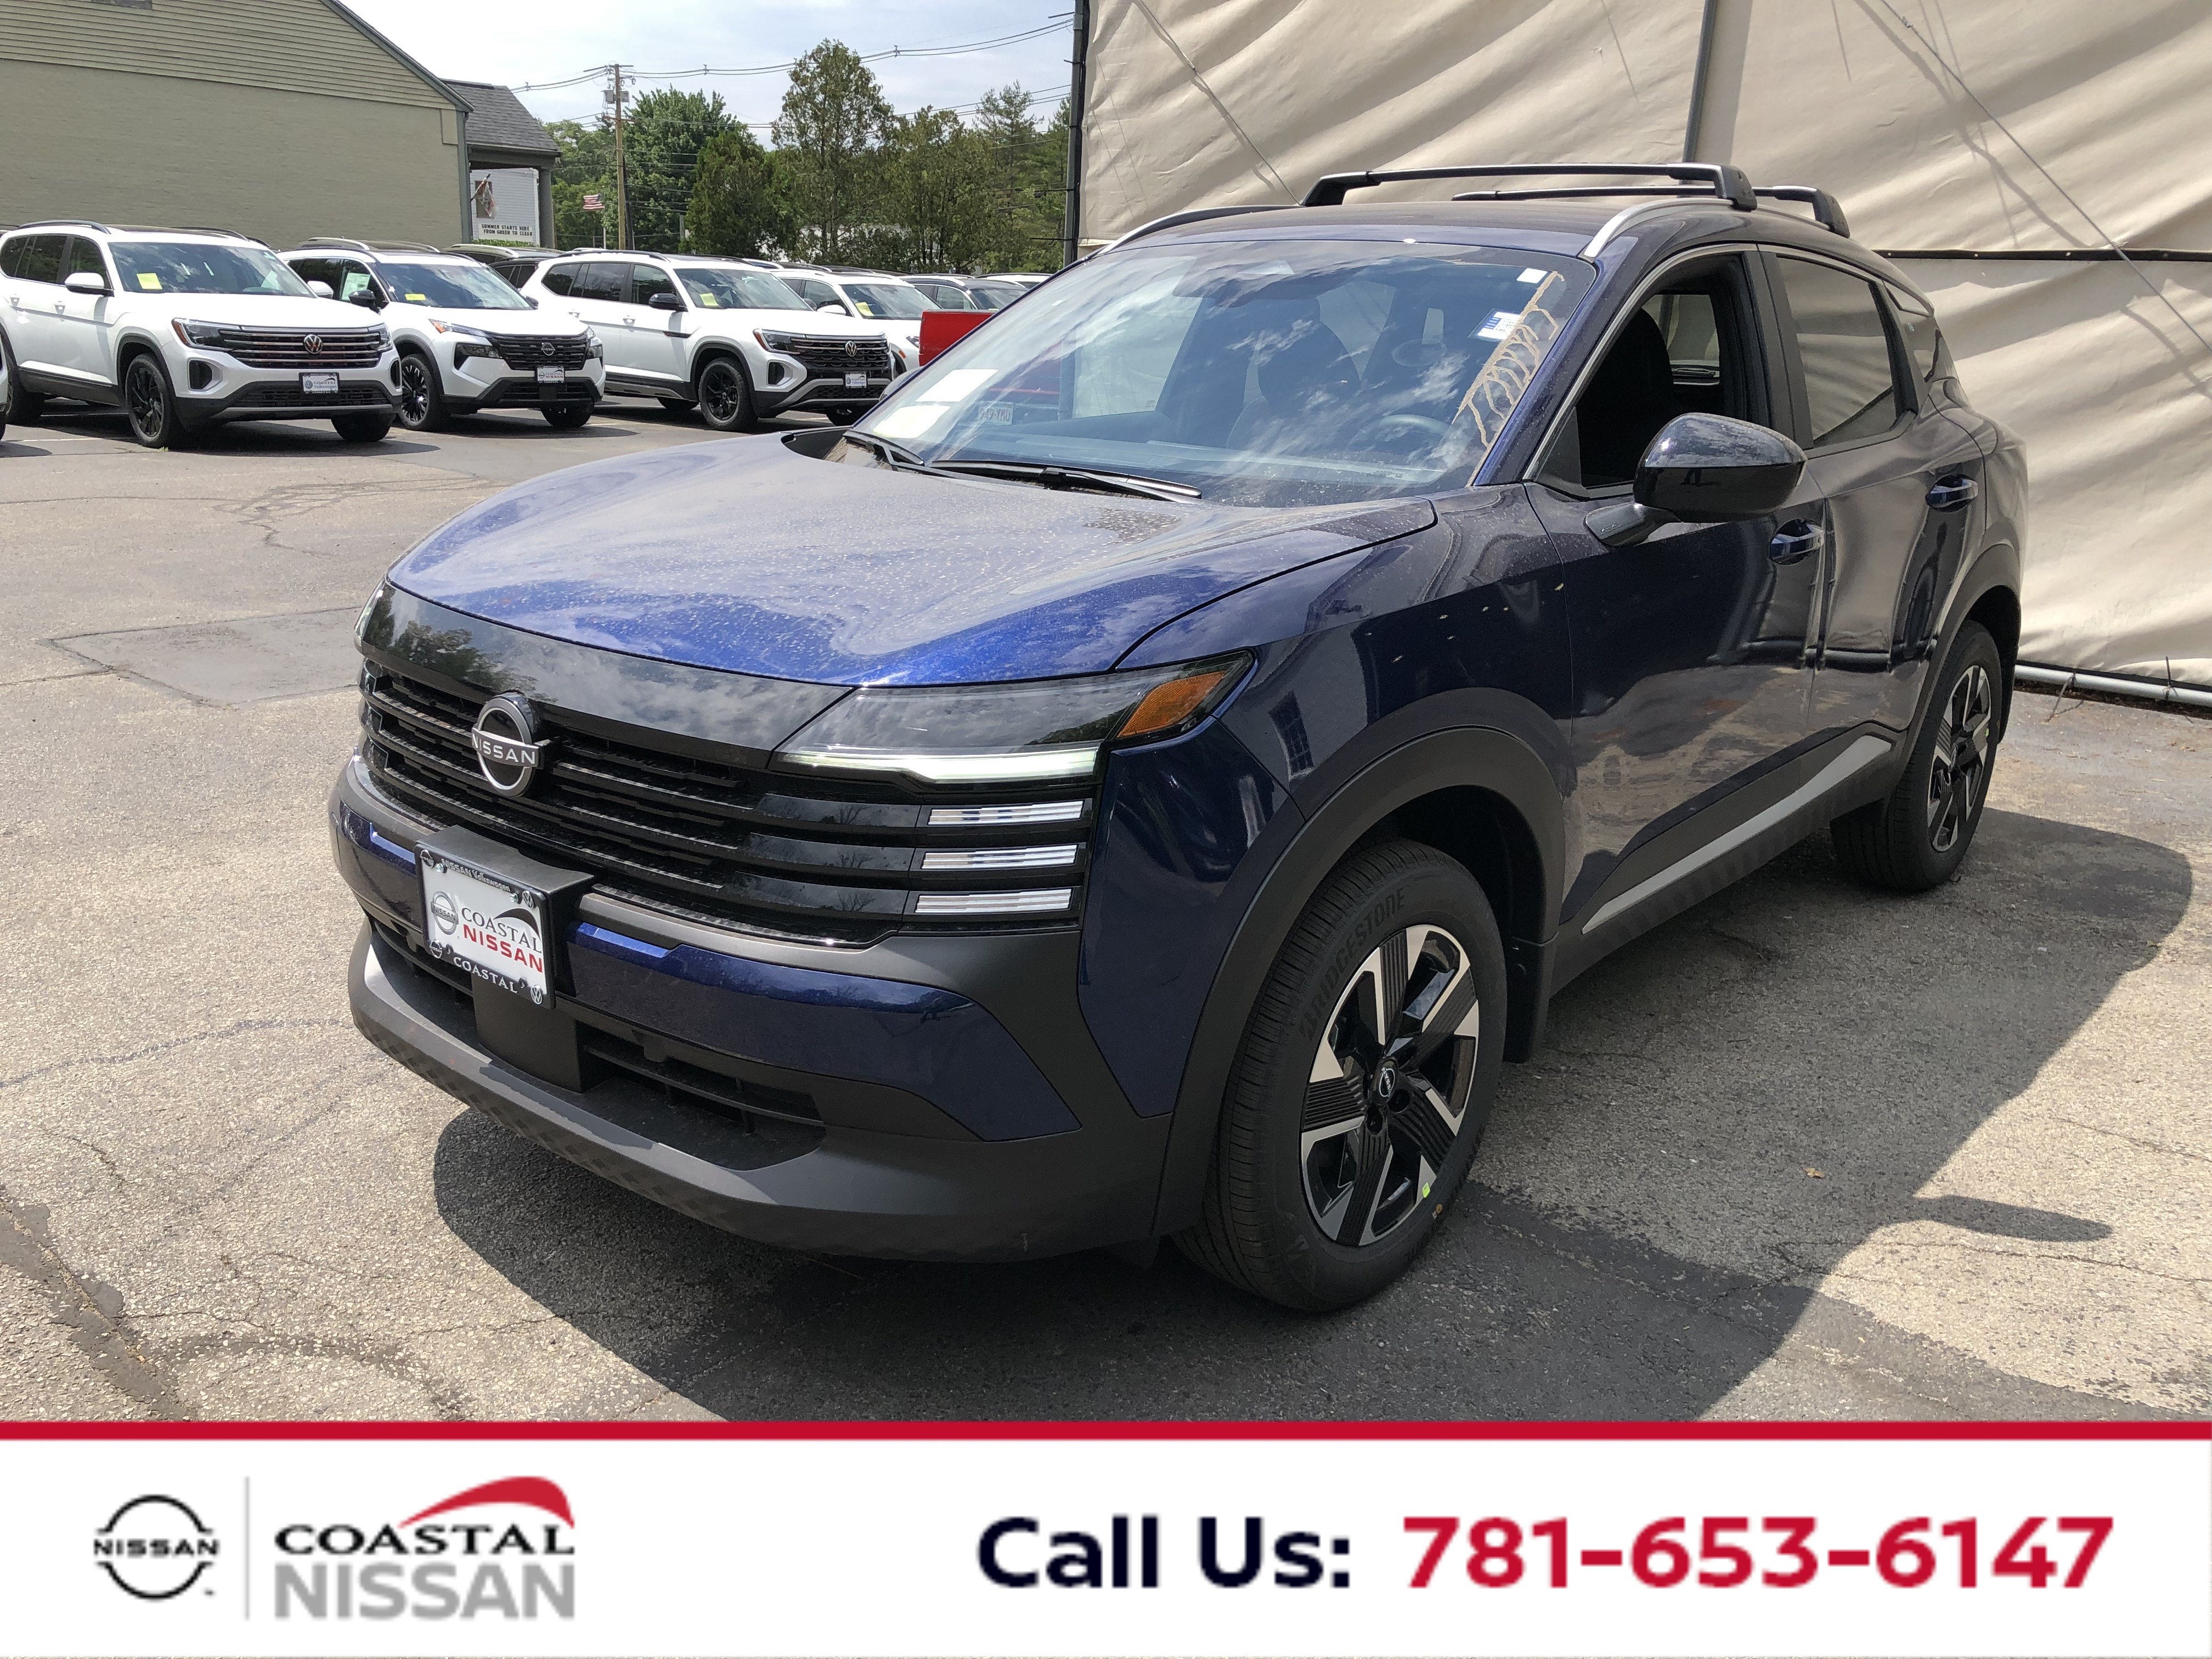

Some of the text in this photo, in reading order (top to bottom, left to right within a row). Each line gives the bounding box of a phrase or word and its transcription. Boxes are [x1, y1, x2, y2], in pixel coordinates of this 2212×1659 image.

[472, 733, 535, 764] NISSAN
[441, 858, 472, 878] NISSAN
[433, 907, 456, 921] NISSAN
[461, 907, 542, 953] COASTAL
[463, 924, 543, 973] NISSAN
[453, 957, 518, 994] COASTAL
